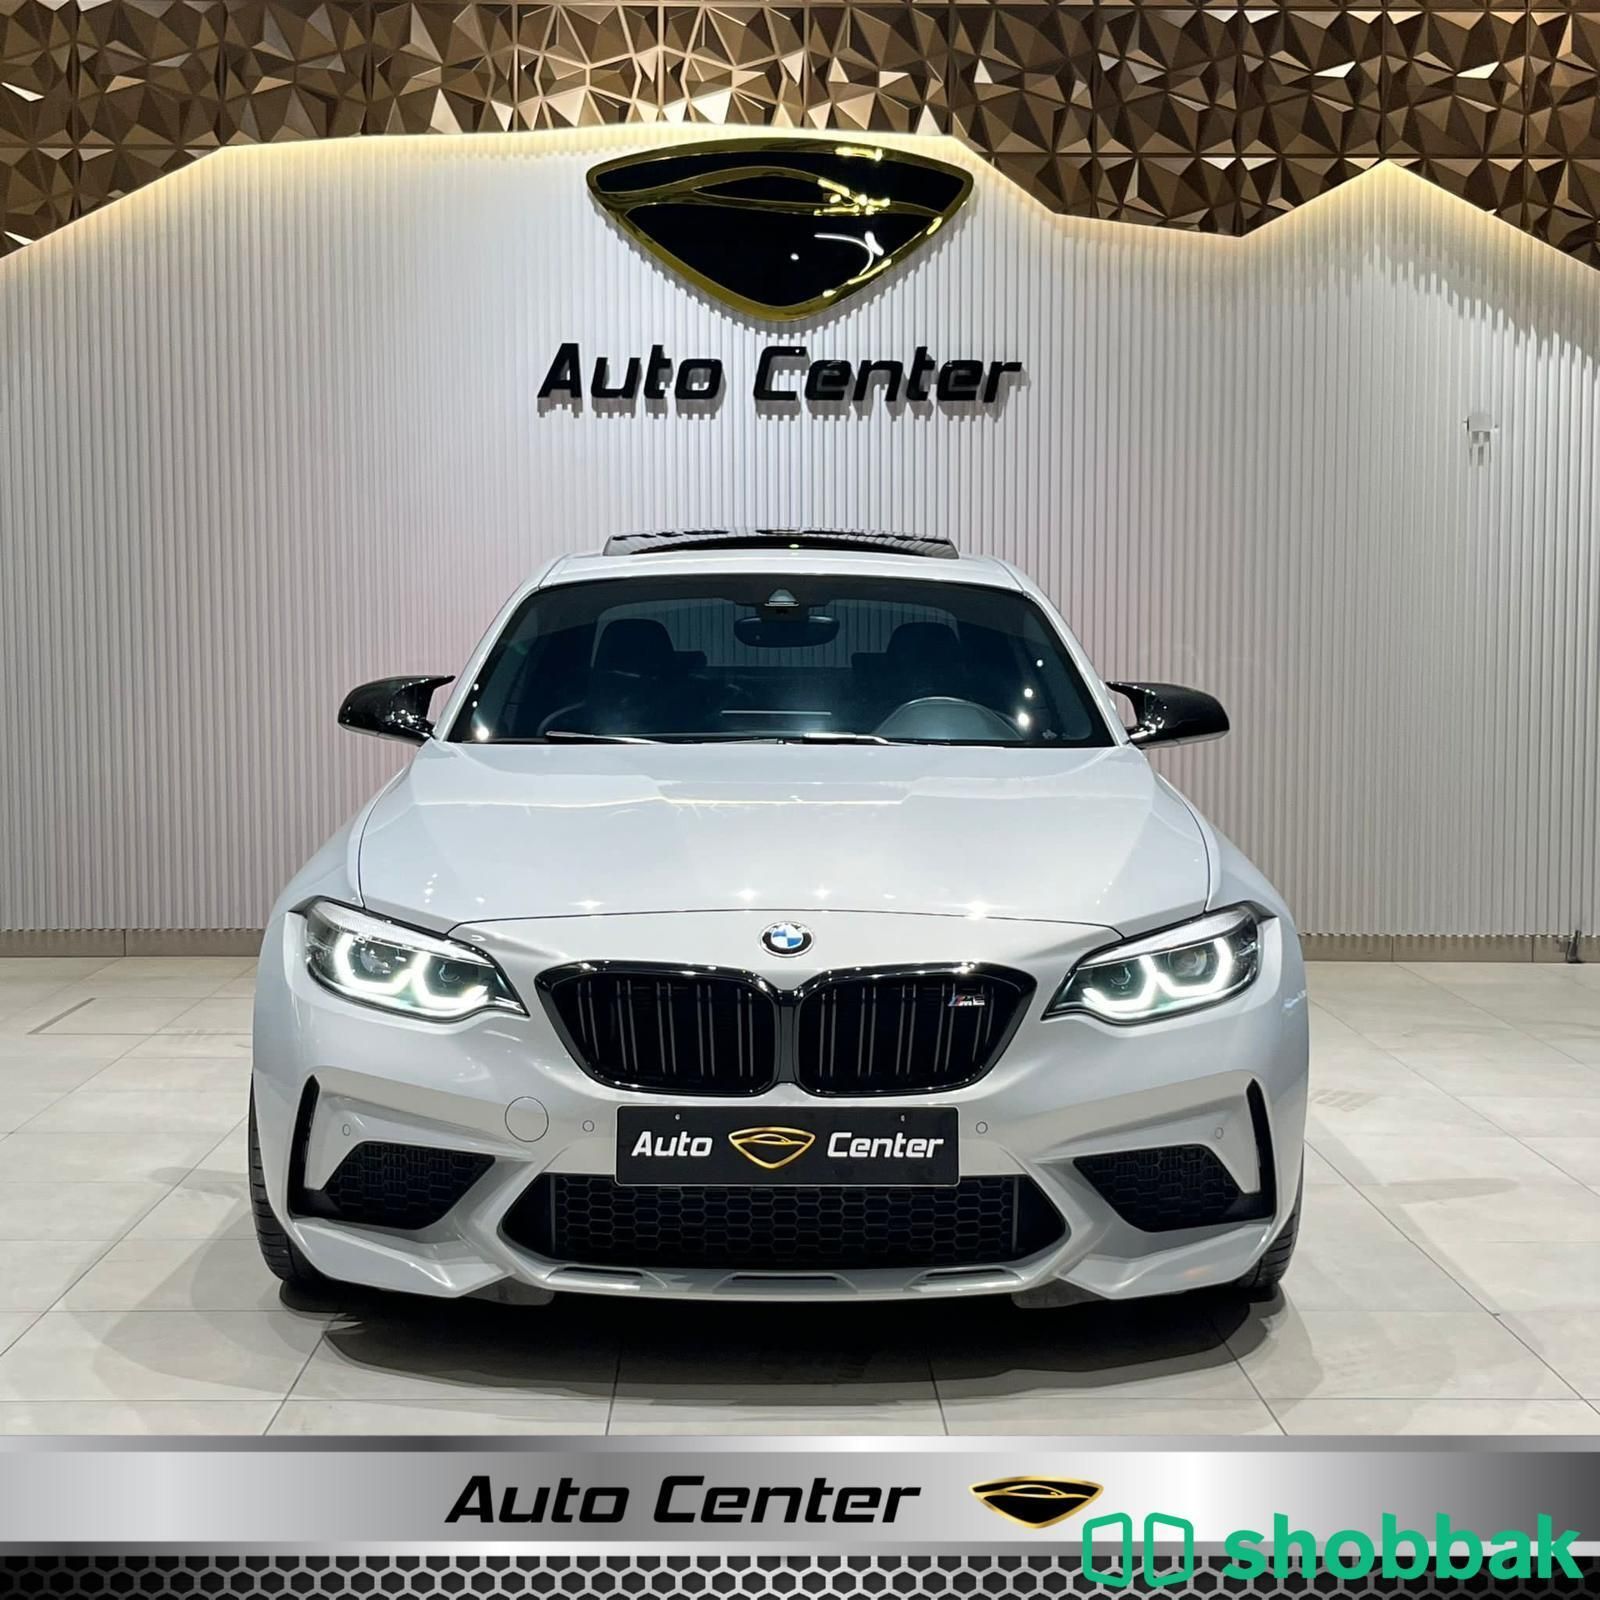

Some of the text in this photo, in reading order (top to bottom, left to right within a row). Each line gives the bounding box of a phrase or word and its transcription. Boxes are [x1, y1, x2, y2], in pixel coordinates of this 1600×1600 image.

[537, 343, 1023, 403] Auto Center
[631, 1131, 945, 1159] Auto Center
